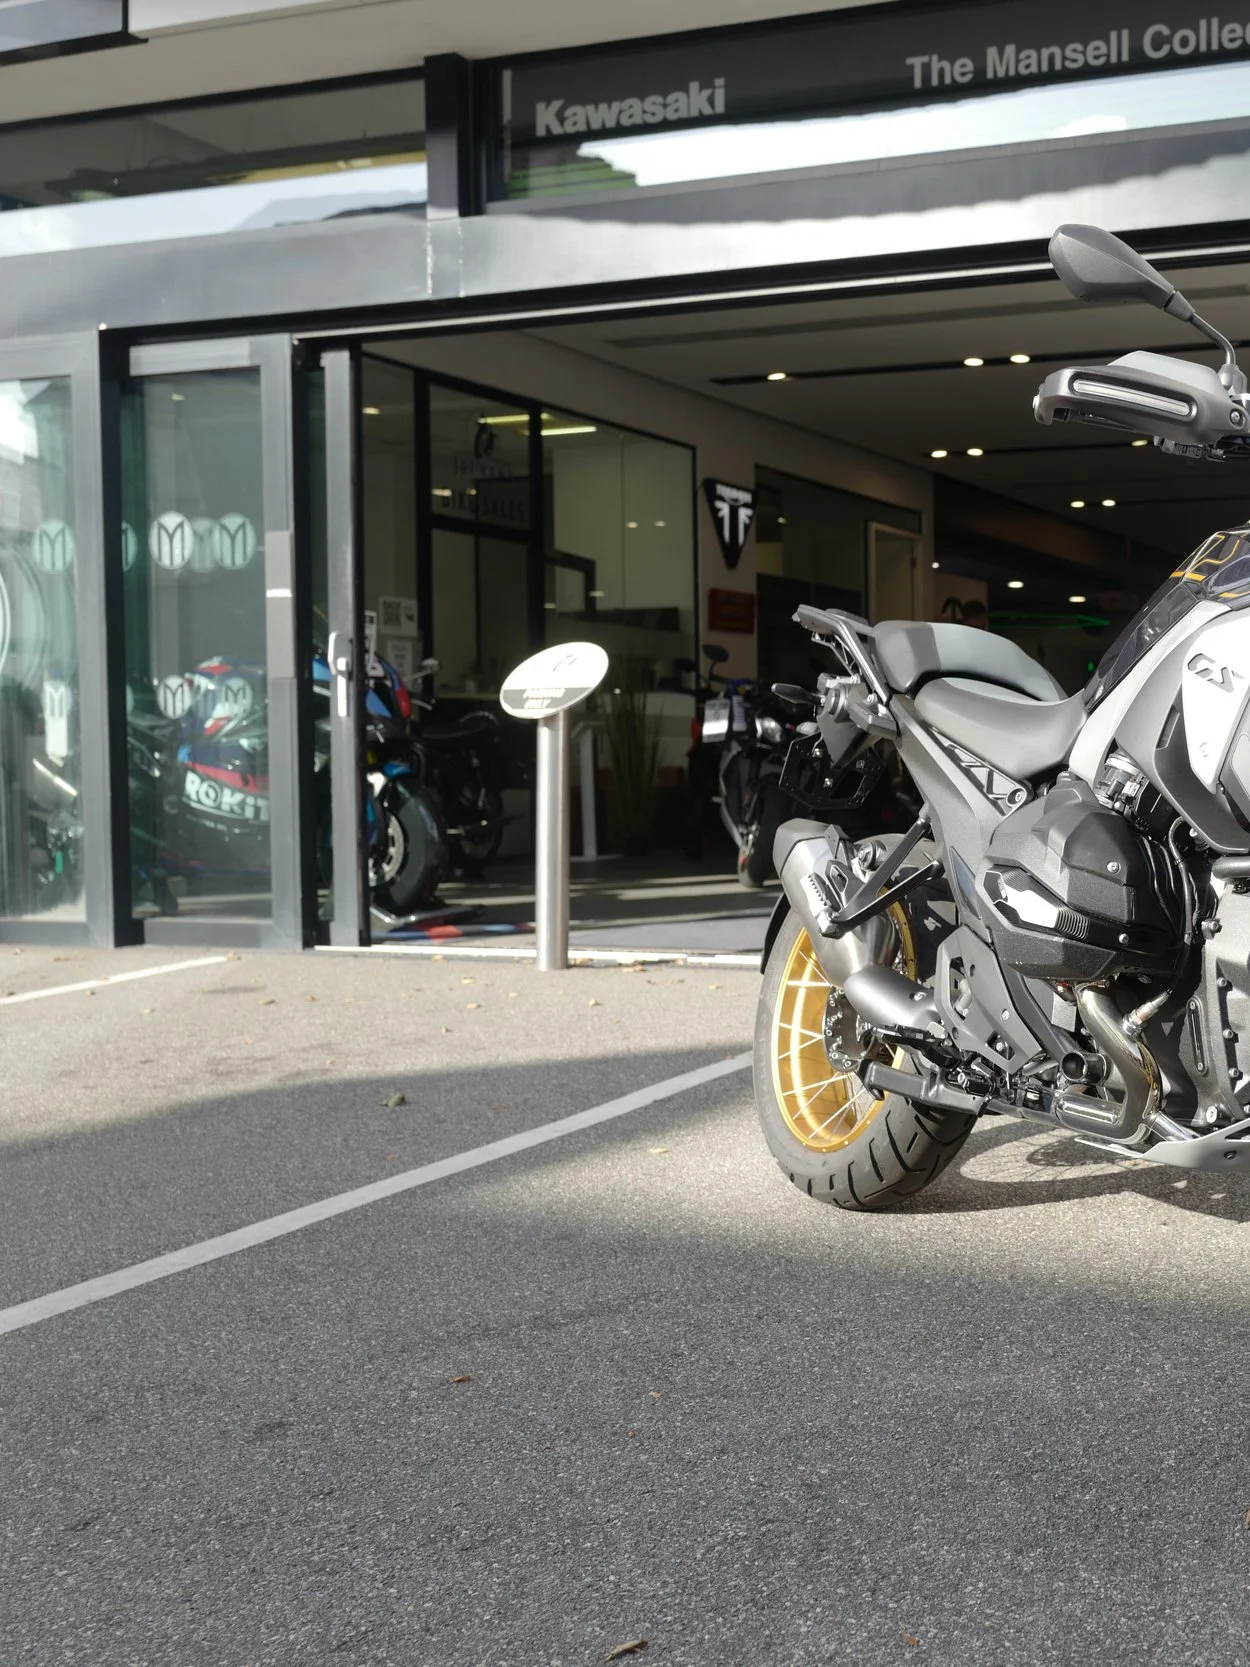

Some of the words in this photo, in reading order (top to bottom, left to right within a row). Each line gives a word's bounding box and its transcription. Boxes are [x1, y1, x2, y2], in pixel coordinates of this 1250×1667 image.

[906, 56, 974, 89] The
[985, 28, 1130, 81] Mansell
[534, 77, 726, 138] Kawasaki
[1187, 652, 1246, 694] GS
